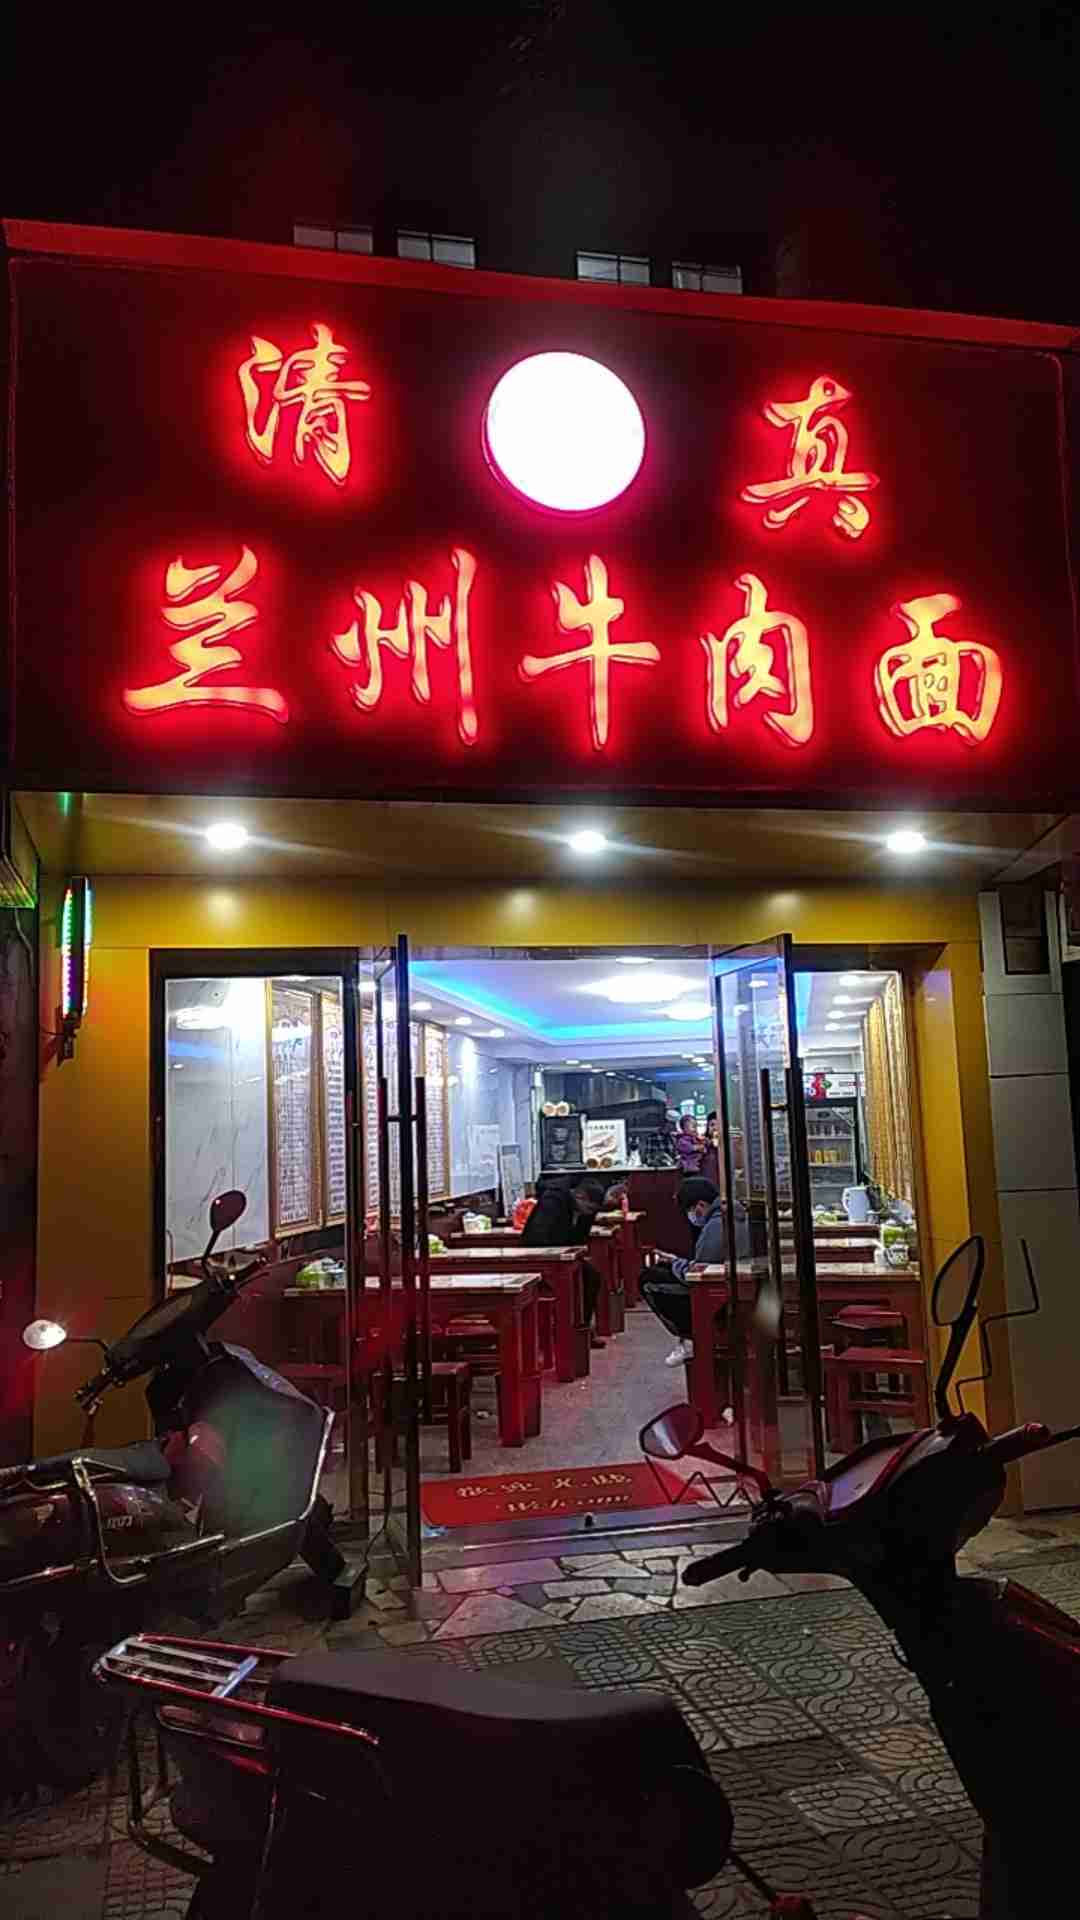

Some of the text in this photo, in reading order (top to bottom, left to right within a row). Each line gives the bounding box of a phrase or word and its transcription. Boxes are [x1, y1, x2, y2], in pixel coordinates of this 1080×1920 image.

[239, 323, 878, 538] 清 真
[124, 545, 1003, 751] 兰州牛肉面
